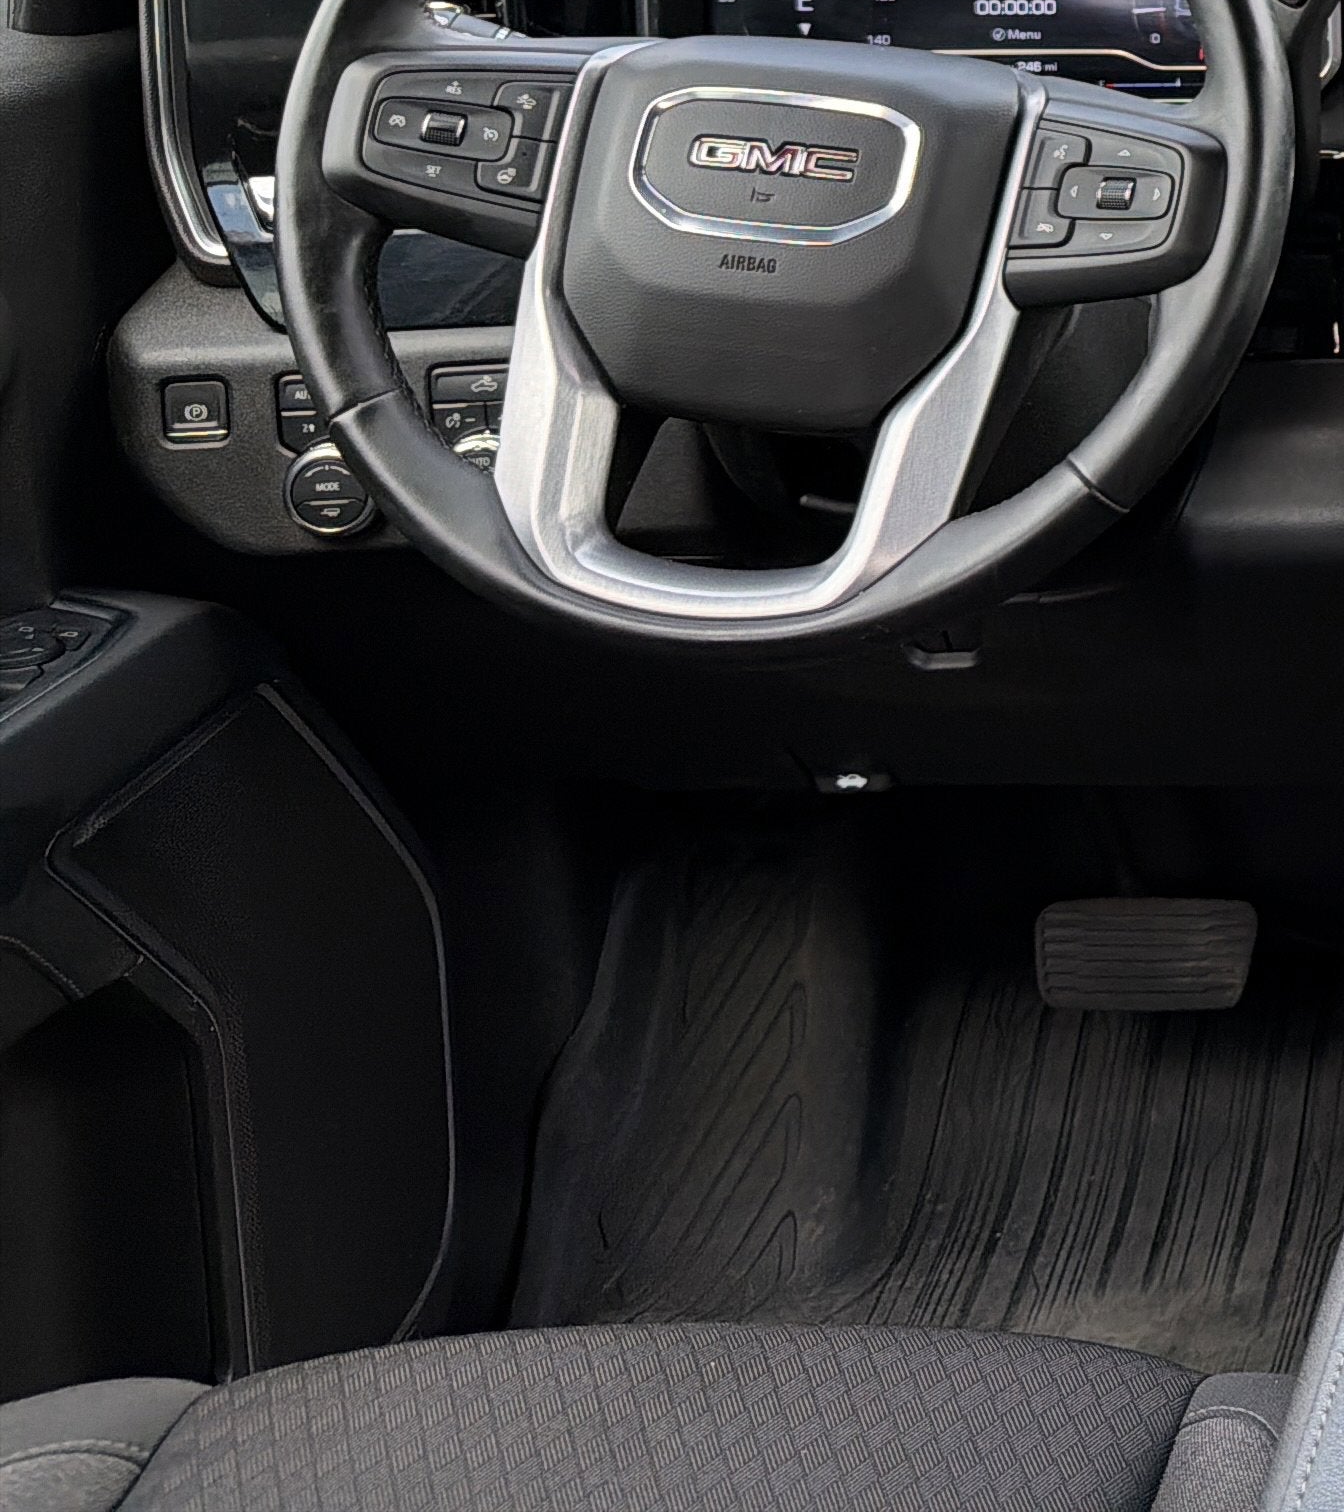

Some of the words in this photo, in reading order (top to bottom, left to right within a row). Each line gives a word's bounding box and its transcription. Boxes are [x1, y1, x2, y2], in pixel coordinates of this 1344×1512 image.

[974, 0, 1057, 15] 00:00:00
[867, 34, 891, 46] 140
[1008, 28, 1042, 40] Menu
[1044, 61, 1058, 71] mi
[688, 135, 859, 182] GMC
[718, 254, 777, 273] AIRBAG
[315, 482, 340, 492] MODE
